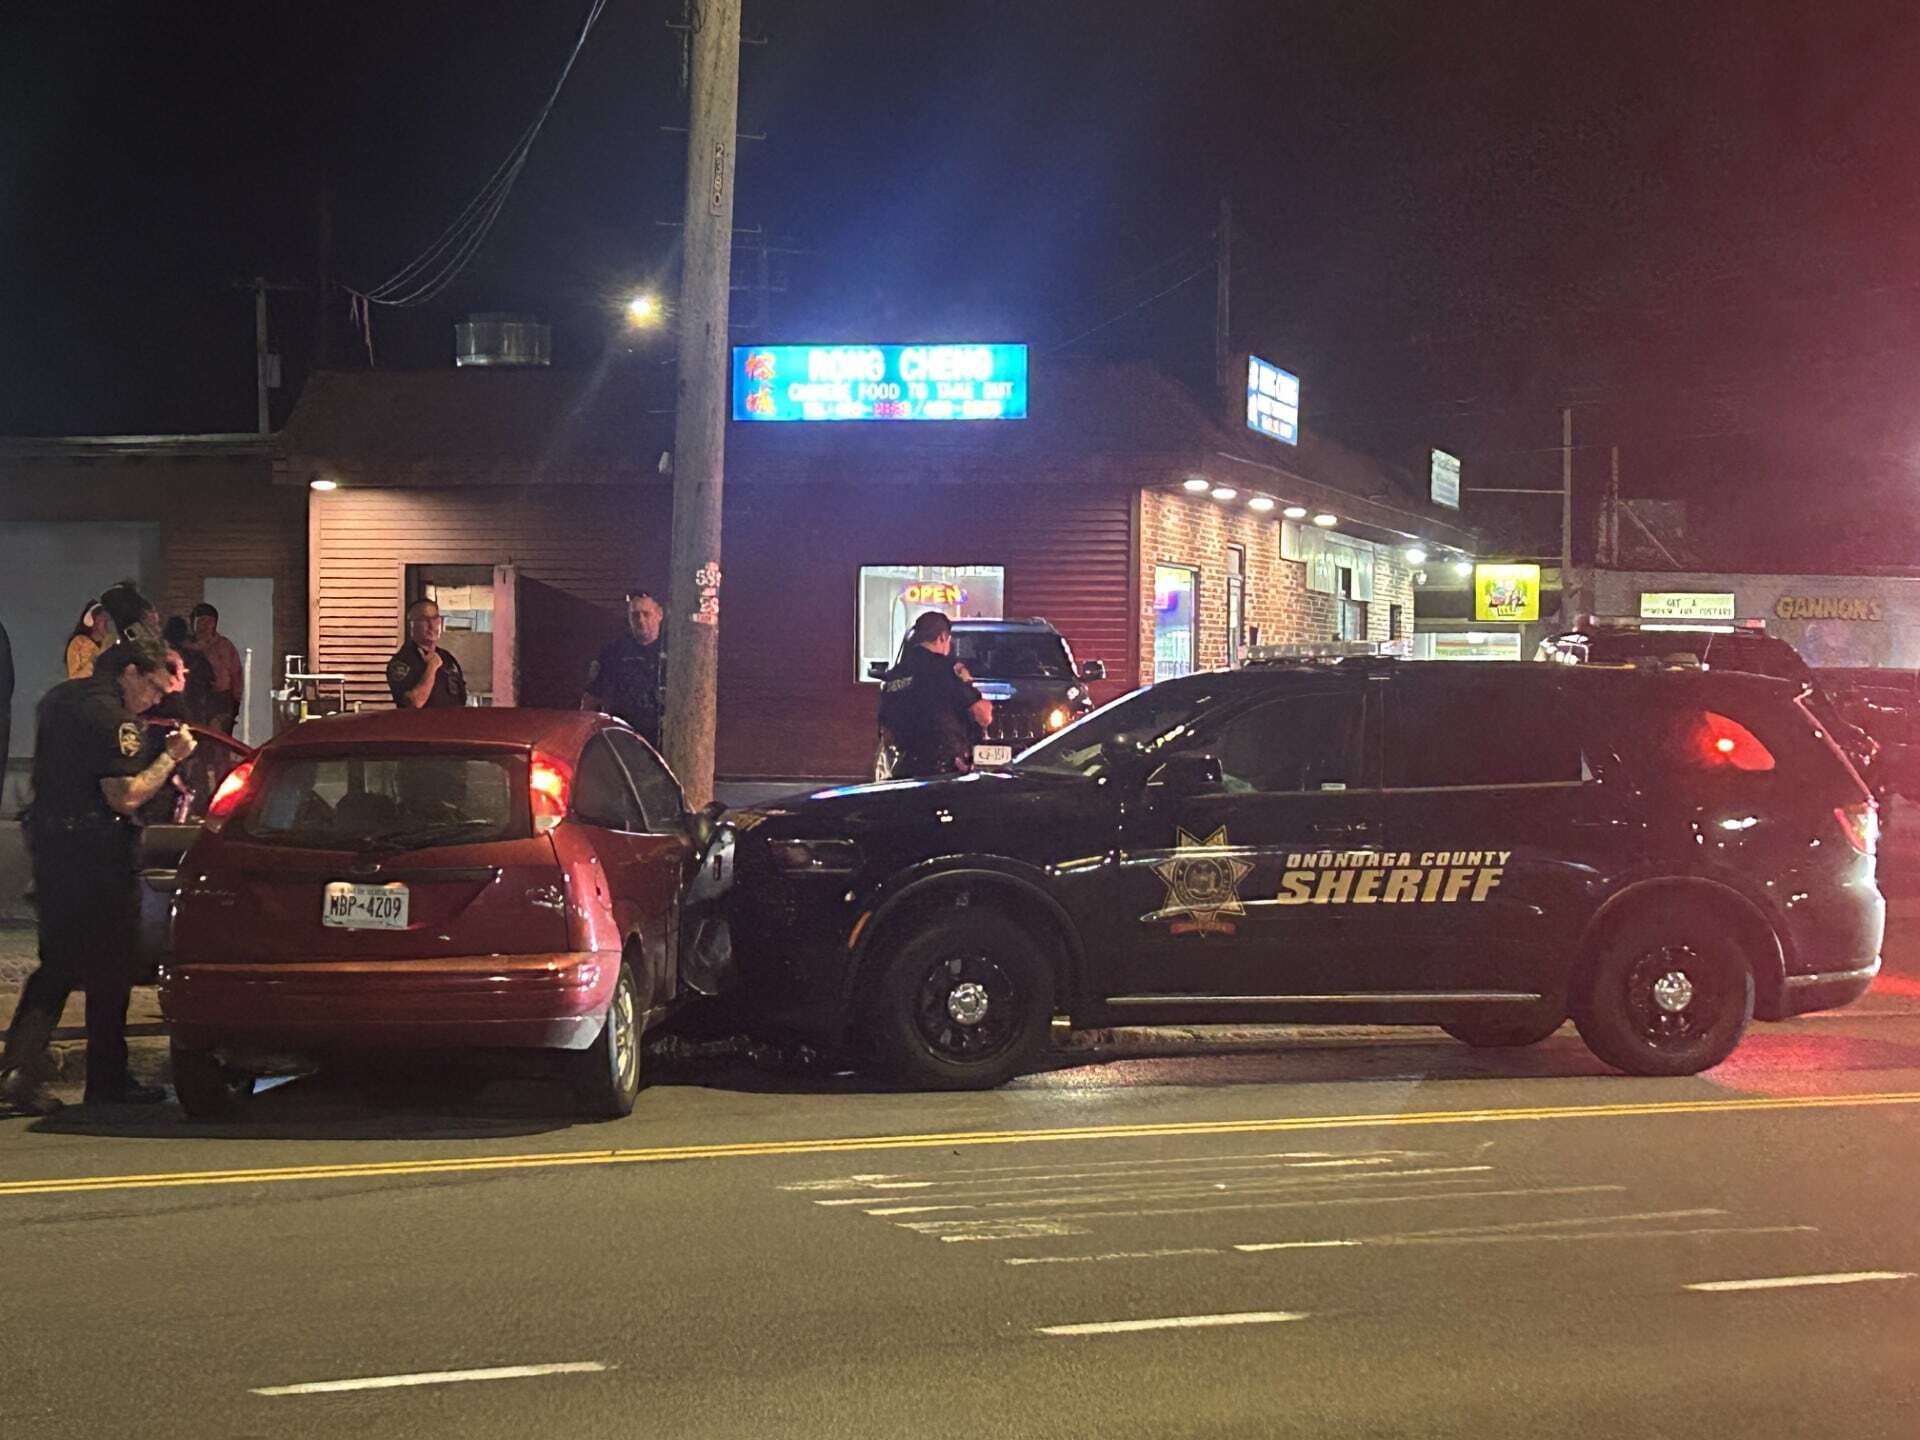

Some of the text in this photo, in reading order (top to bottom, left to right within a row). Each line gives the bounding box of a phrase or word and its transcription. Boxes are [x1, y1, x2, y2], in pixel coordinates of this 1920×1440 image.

[858, 383, 900, 400] FOOD
[905, 583, 961, 605] OPEN
[1286, 851, 1512, 869] ONONDAGA COUNTY
[1276, 868, 1504, 904] SHERIFF
